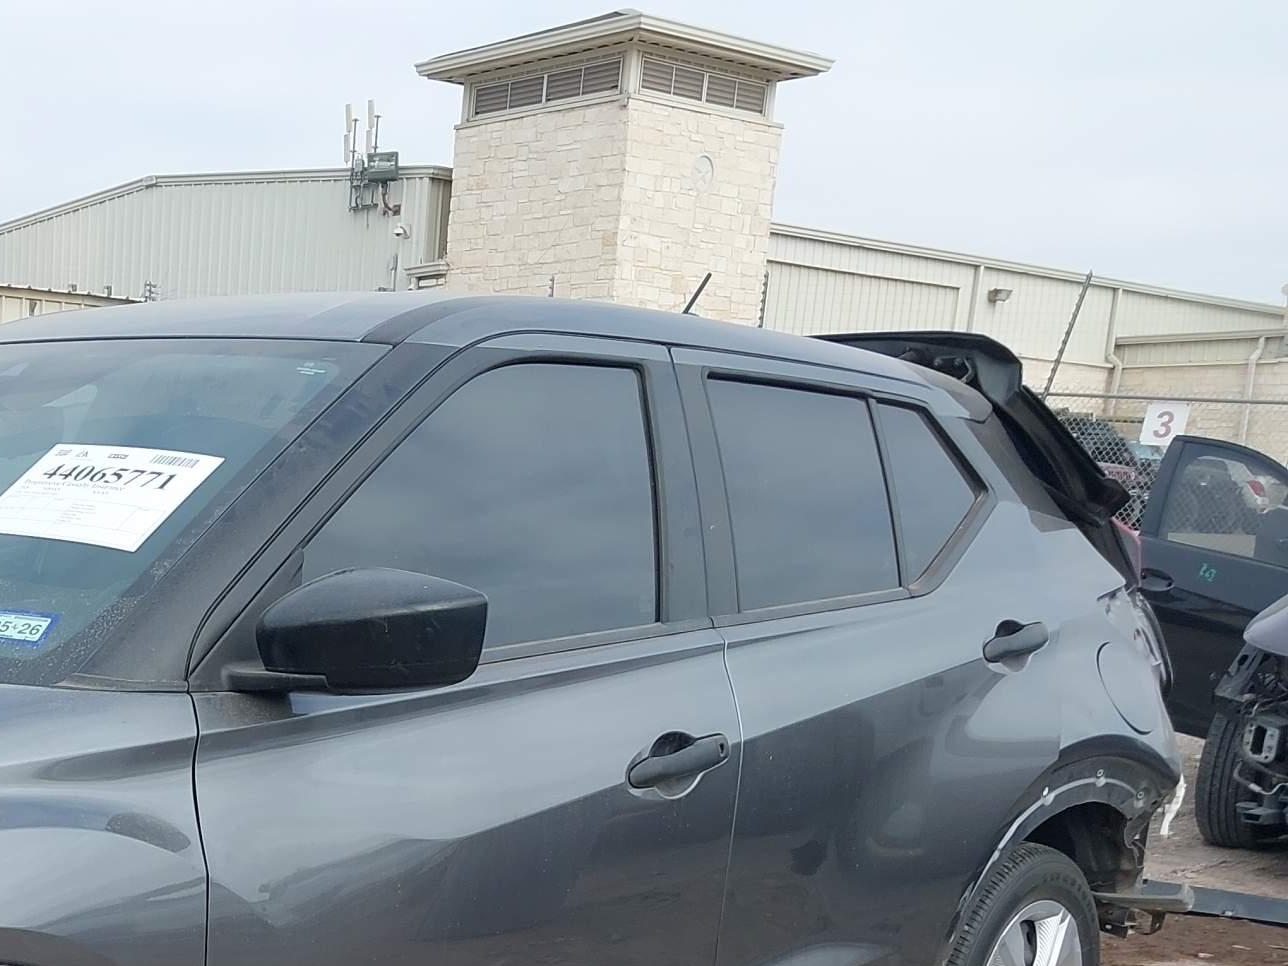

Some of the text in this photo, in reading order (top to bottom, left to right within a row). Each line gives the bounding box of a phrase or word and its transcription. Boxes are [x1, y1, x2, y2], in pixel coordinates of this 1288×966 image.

[1153, 410, 1175, 438] 3
[42, 463, 178, 490] 44065771
[16, 622, 42, 636] 26
